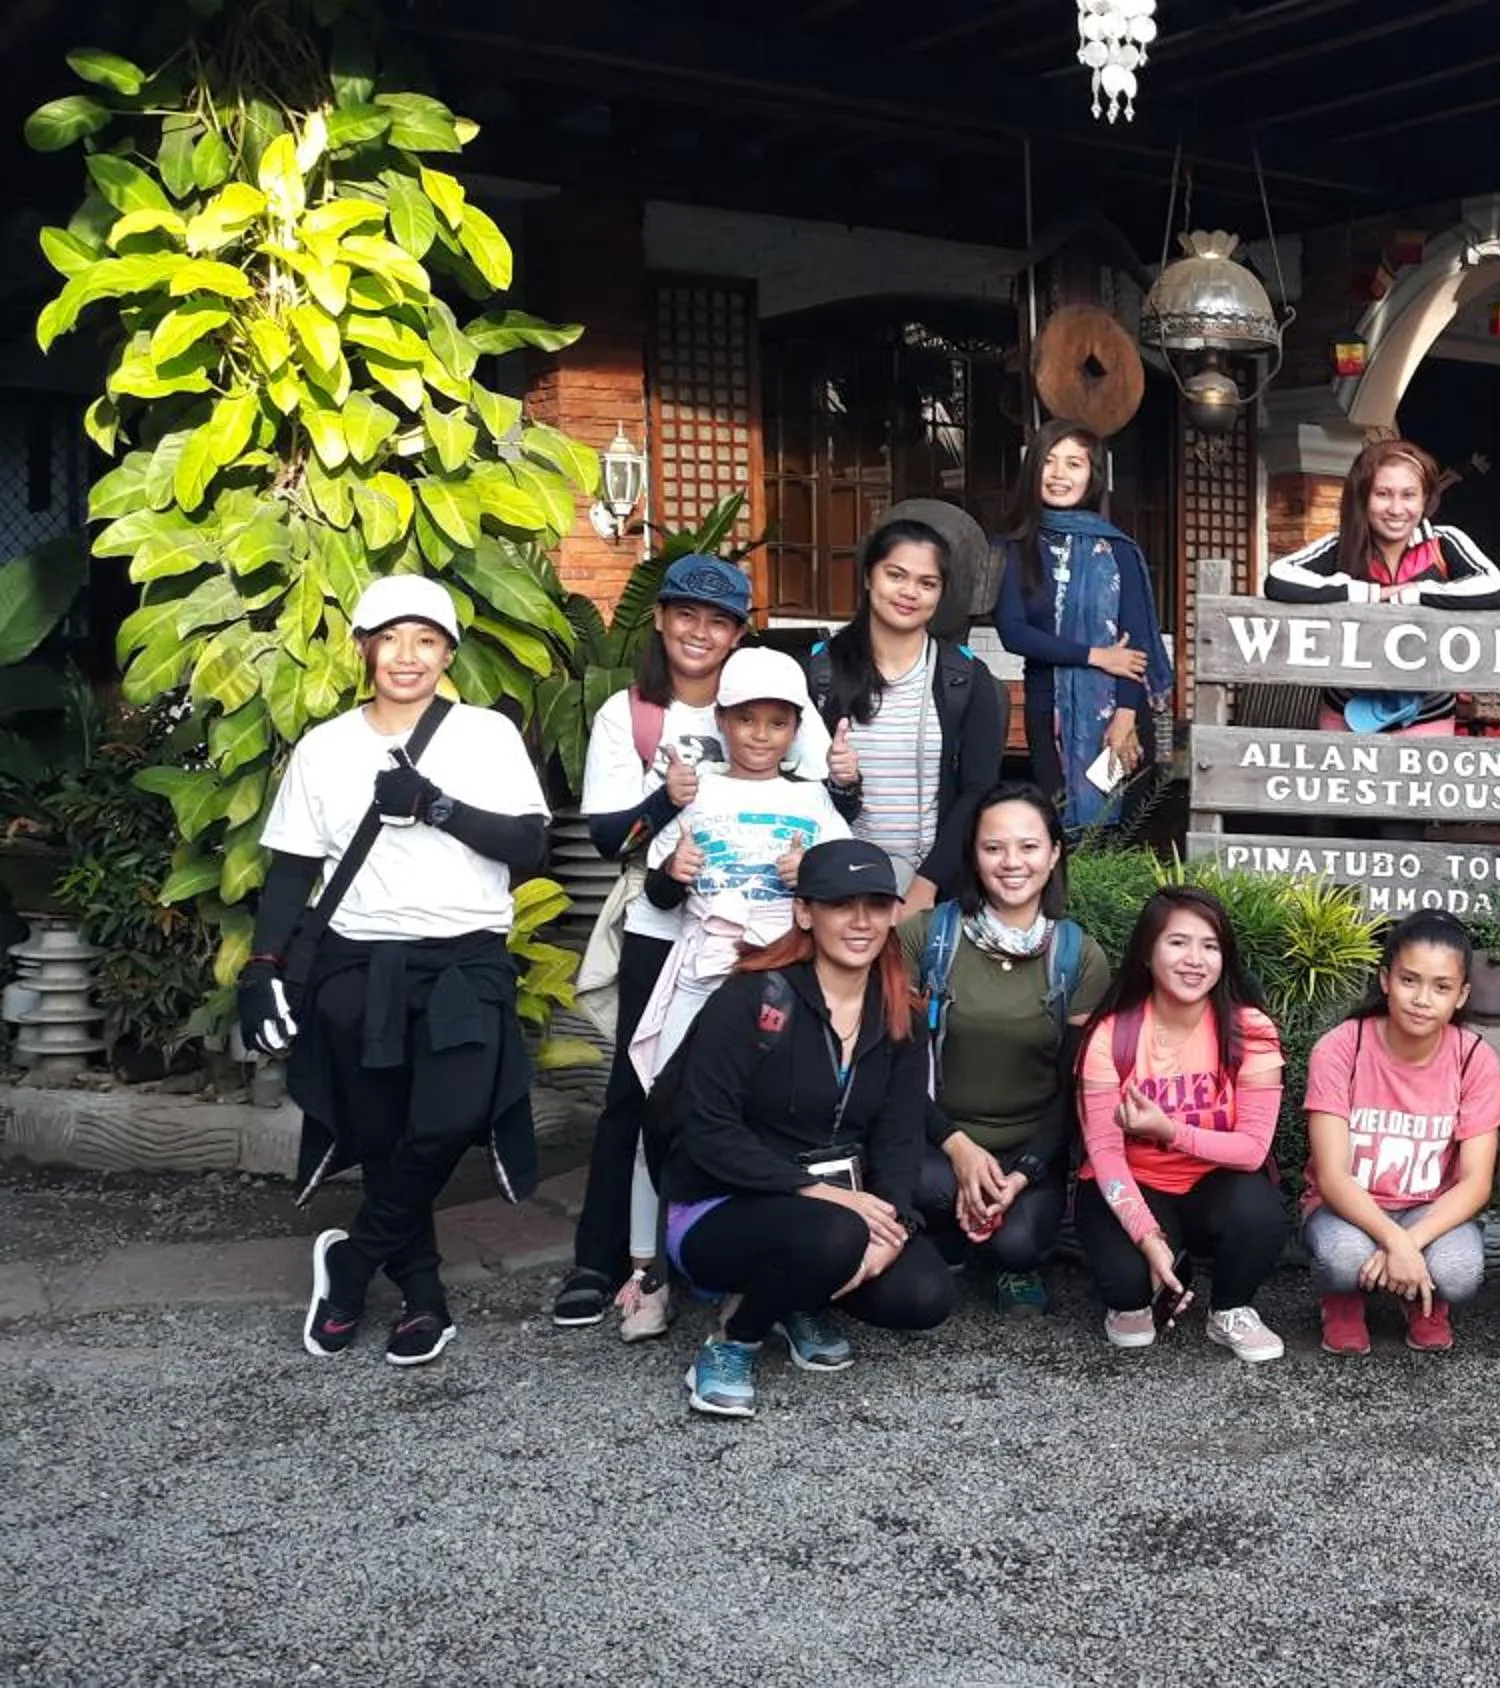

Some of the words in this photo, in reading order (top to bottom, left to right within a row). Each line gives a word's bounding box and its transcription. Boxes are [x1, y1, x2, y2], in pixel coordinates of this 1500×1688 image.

[1239, 742, 1380, 773] ALLAN
[1226, 845, 1421, 879] PINATUBO
[1349, 1107, 1428, 1139] YIELDED
[1429, 1114, 1454, 1140] TO
